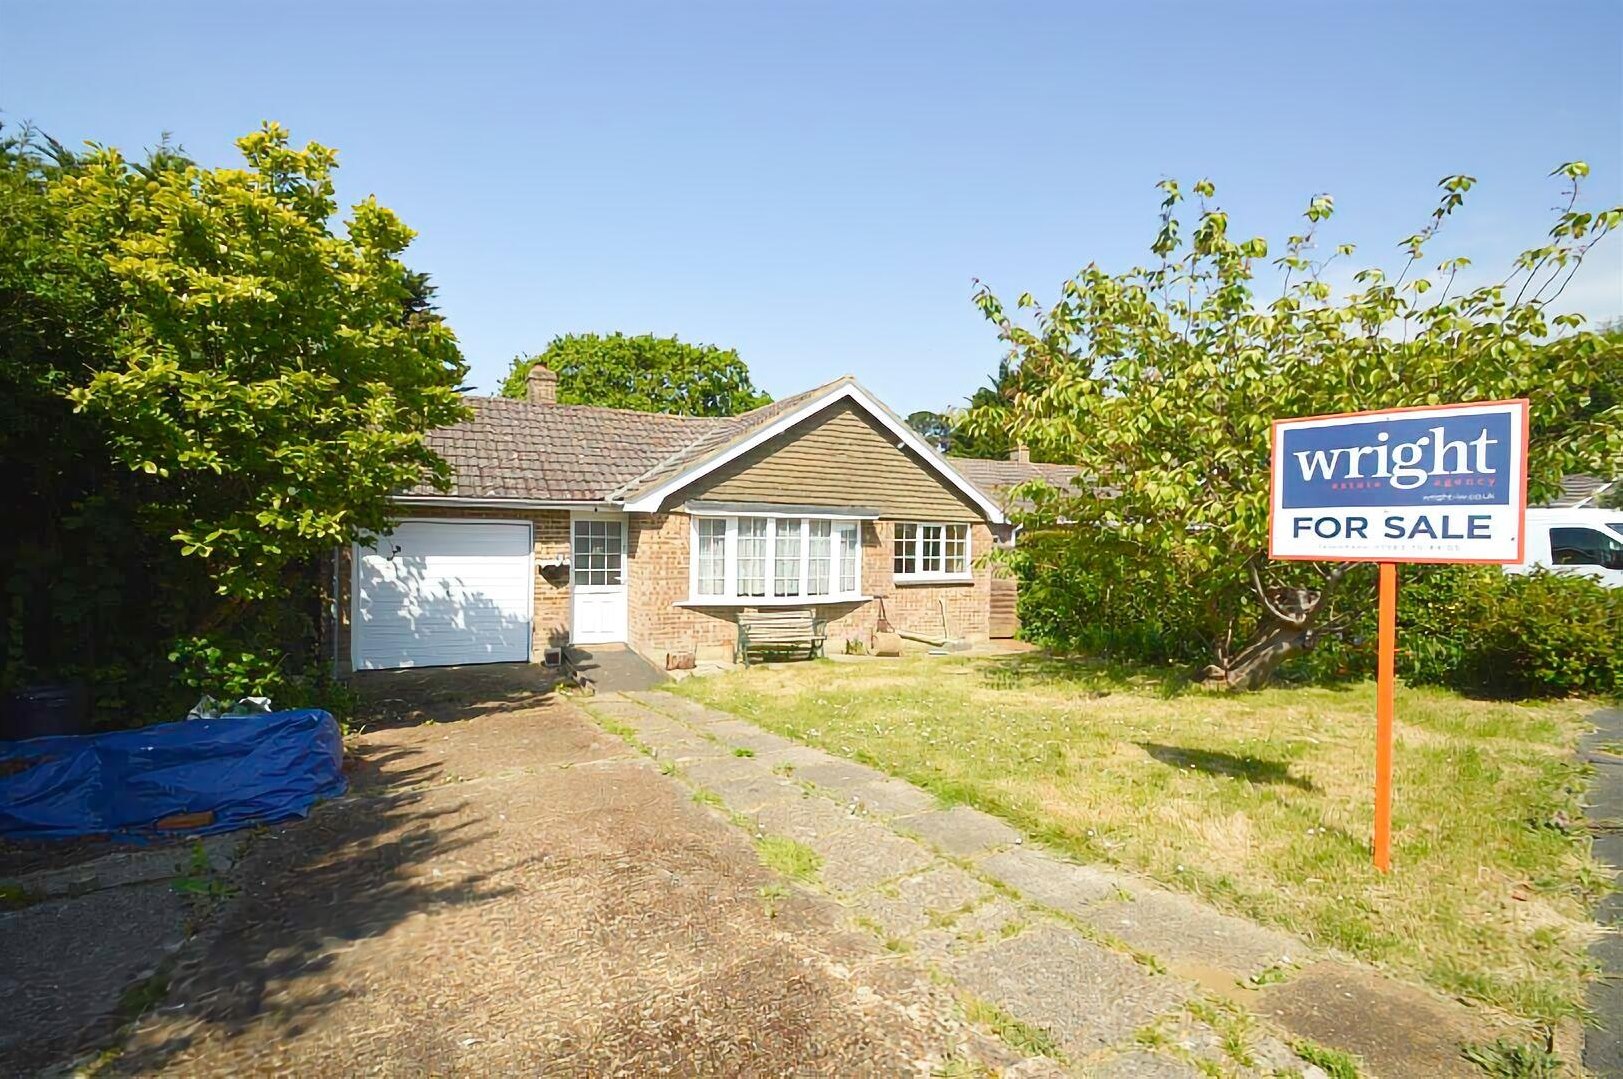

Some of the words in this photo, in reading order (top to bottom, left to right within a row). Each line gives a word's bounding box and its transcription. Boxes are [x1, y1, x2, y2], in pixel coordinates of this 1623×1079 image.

[1293, 426, 1498, 489] wright
[1434, 477, 1496, 488] agency
[1293, 517, 1368, 539] FOR
[1384, 515, 1492, 539] SALE
